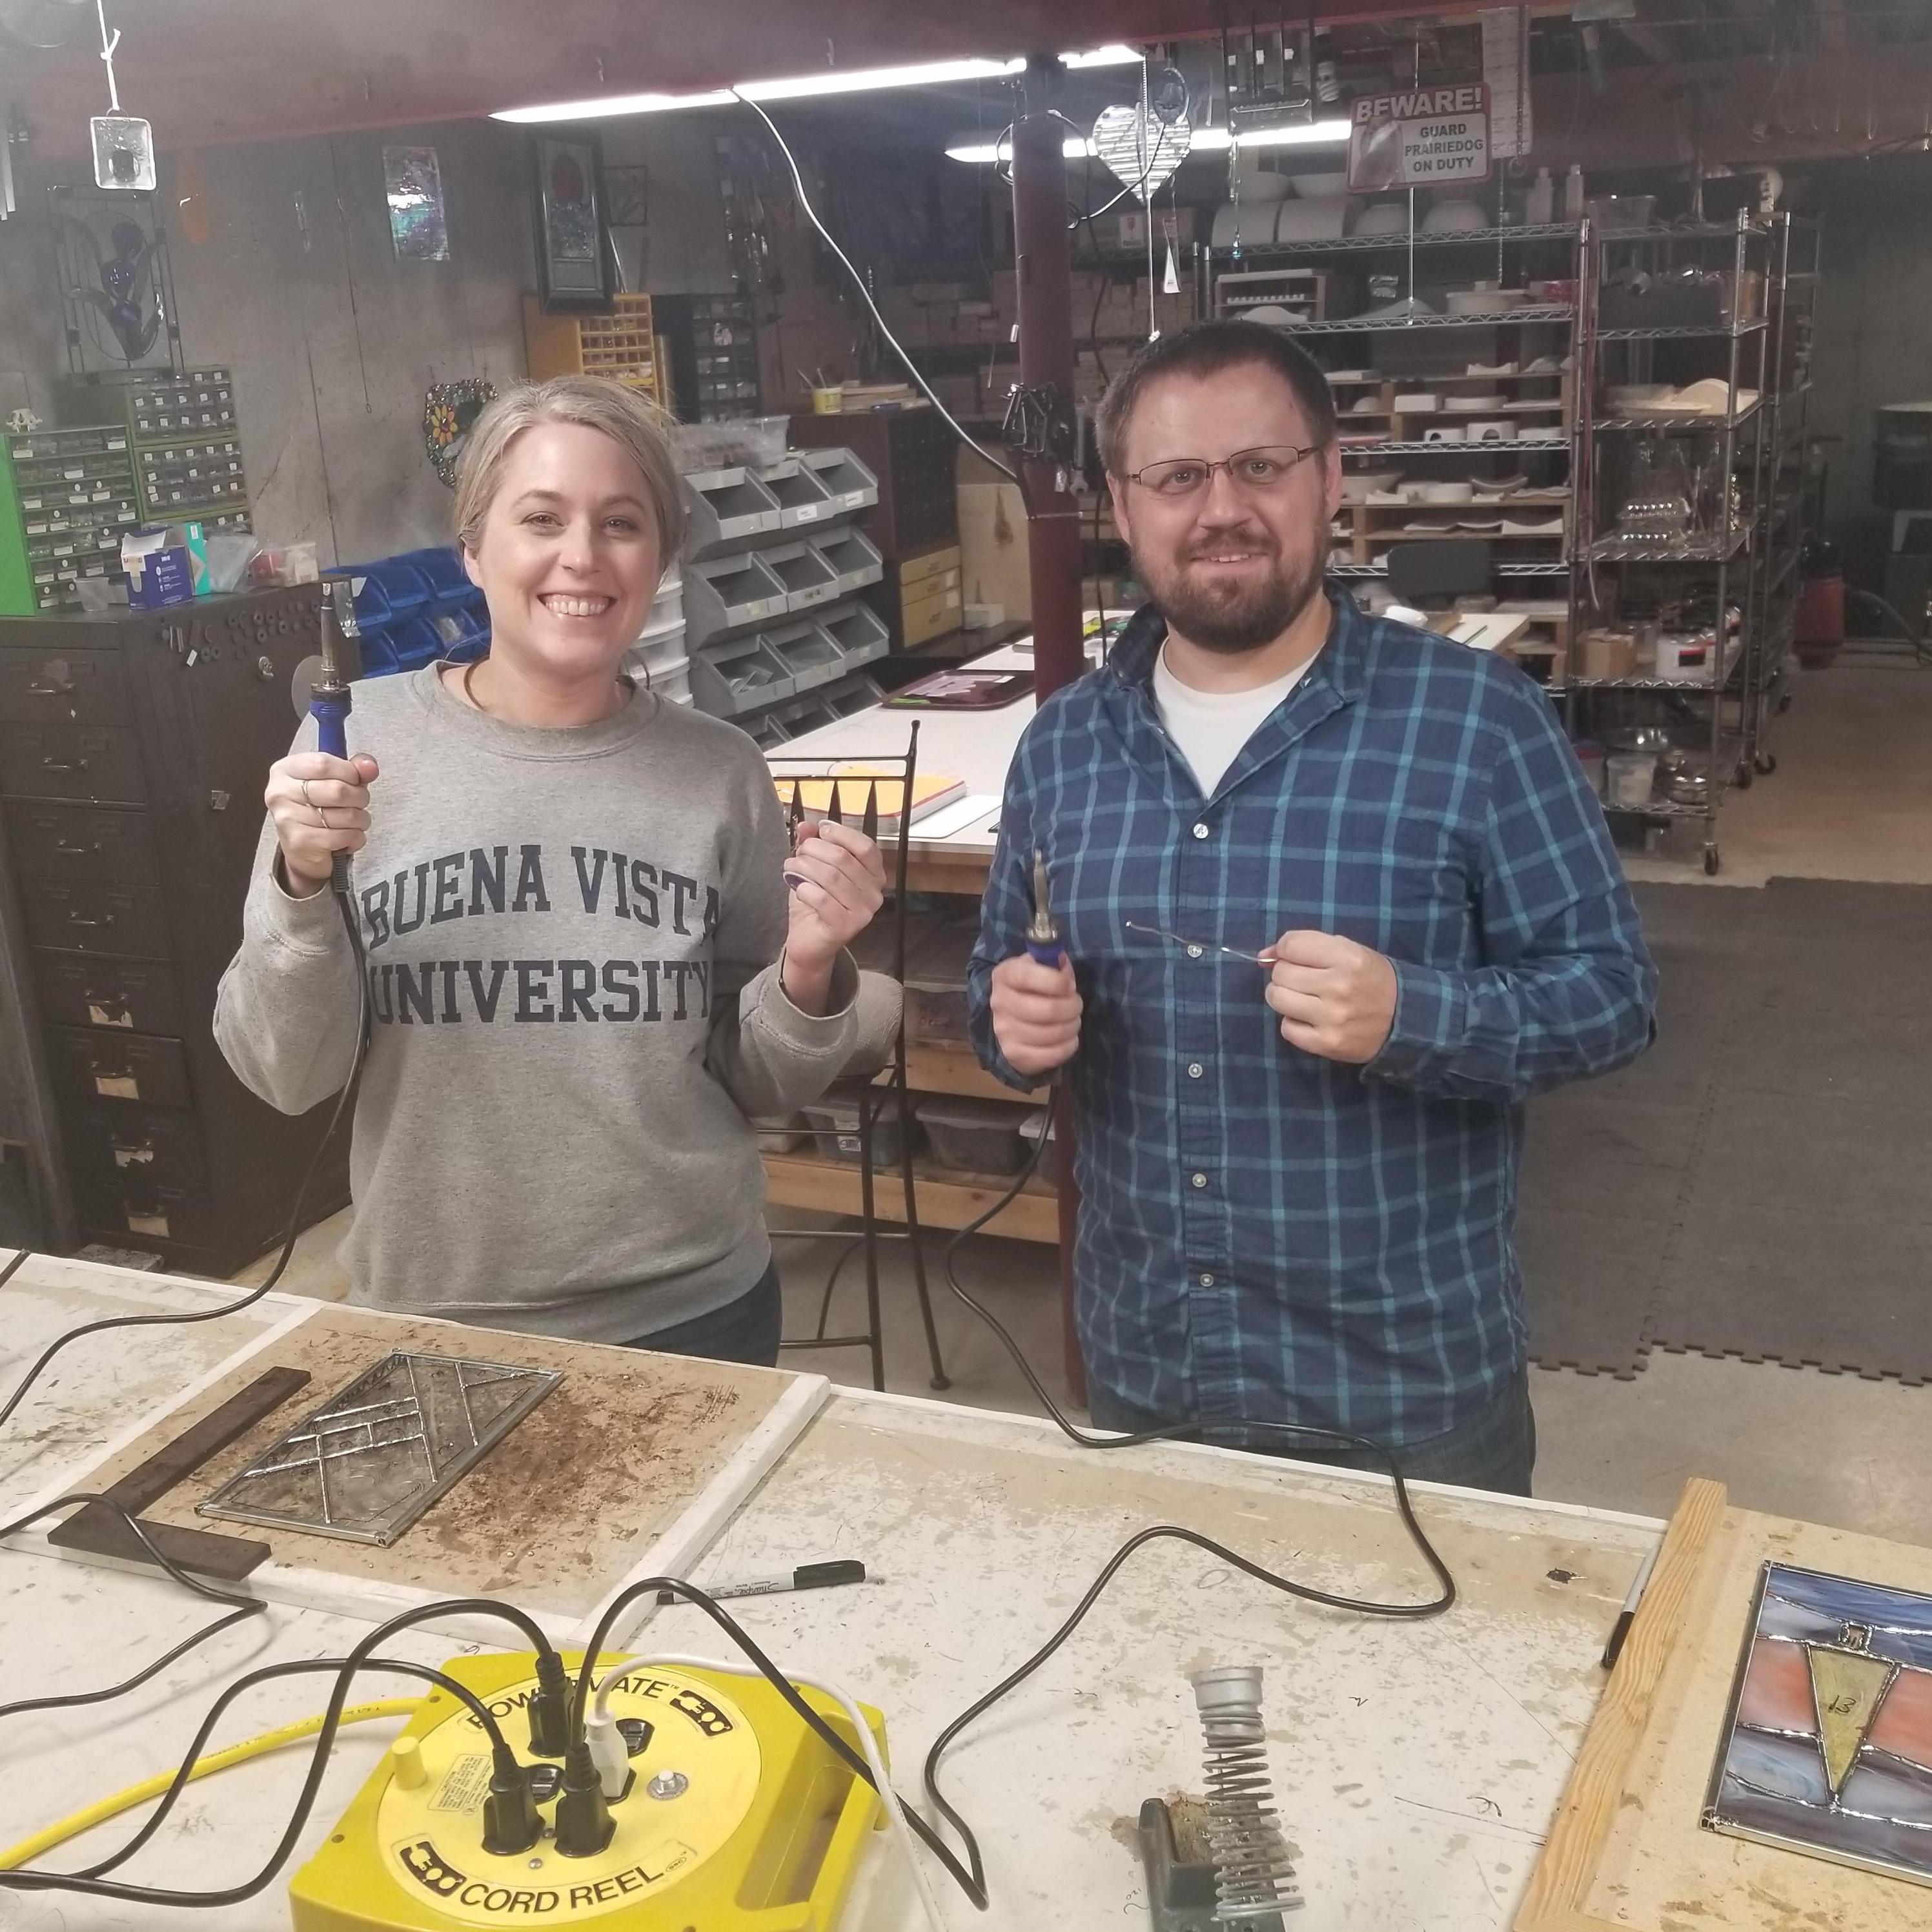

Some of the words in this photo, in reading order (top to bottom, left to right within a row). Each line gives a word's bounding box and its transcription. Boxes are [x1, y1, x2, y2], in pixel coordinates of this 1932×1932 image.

[1356, 87, 1483, 124] BEWARE!
[1405, 139, 1484, 157] PRAIRIEDOG
[1420, 123, 1467, 137] GUARD
[1413, 161, 1432, 172] ON
[1437, 156, 1474, 171] DUTY
[361, 844, 551, 951] BUENA
[571, 846, 720, 946] VISTA
[370, 959, 710, 1026] UNIVERSITY
[460, 1883, 560, 1914] CORD
[570, 1866, 664, 1909] REEL
